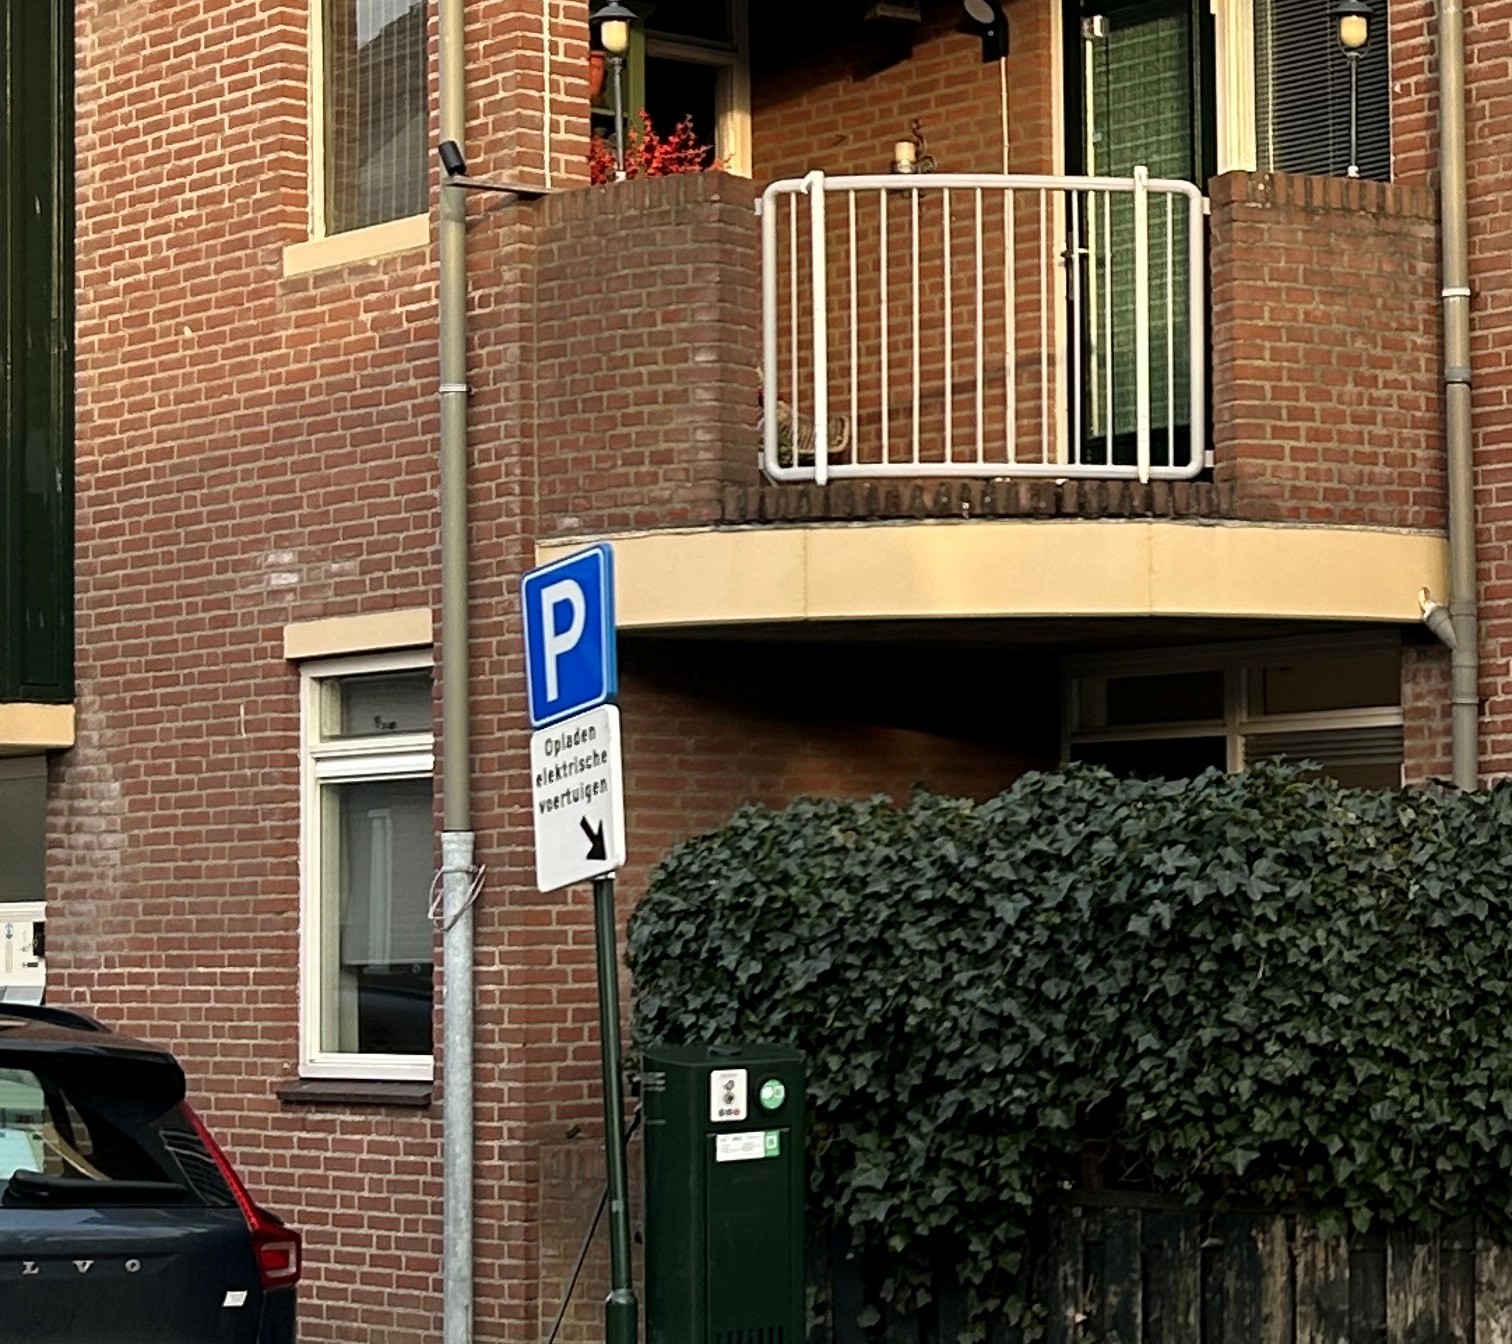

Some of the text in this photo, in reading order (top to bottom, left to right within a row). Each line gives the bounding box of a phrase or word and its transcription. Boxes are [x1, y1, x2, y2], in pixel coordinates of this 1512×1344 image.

[541, 578, 586, 702] P
[545, 725, 597, 758] Opladen
[536, 748, 607, 788] elektrische
[539, 777, 608, 814] voertuigen
[21, 1258, 141, 1275] LVO
